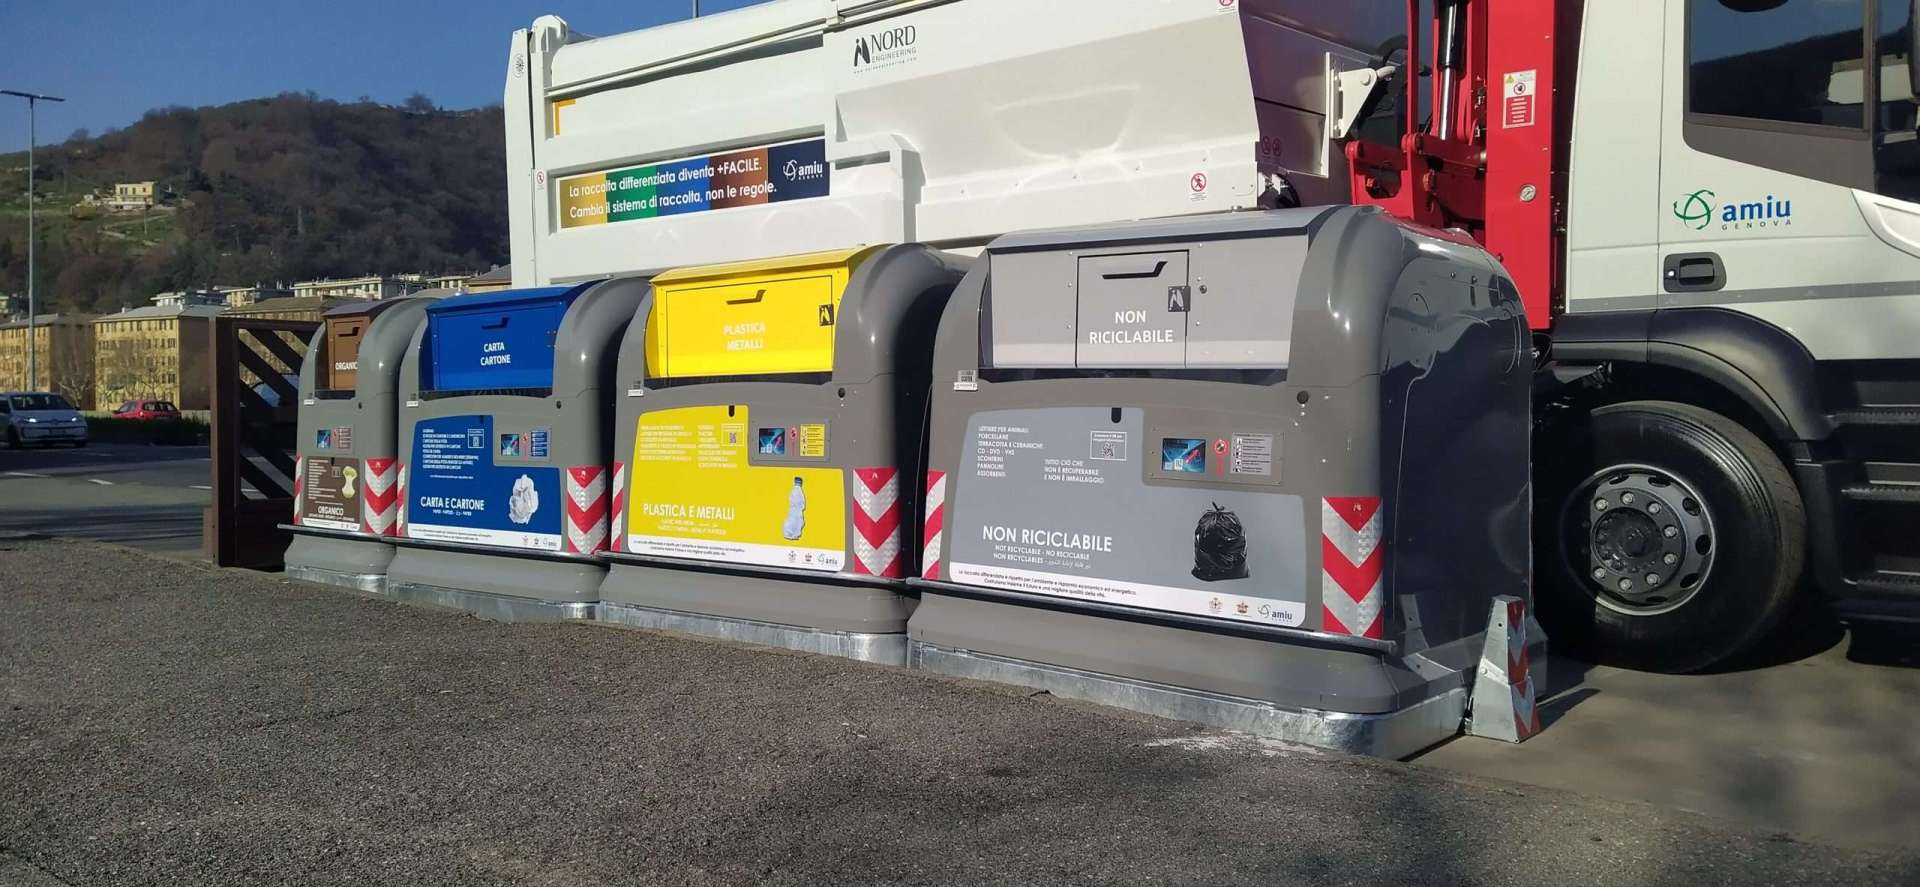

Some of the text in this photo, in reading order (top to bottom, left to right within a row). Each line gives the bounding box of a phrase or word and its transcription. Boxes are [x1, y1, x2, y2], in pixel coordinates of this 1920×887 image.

[871, 25, 916, 53] NORD
[871, 47, 917, 63] ENGINEERING
[798, 161, 823, 176] amiu
[569, 158, 762, 198] La raccolta differenziata diventa +FACILE.
[569, 180, 778, 218] Cambia il sistema di raccolta, non le regole.
[1722, 195, 1791, 222] amiu
[1721, 220, 1792, 231] GENOVA
[1114, 310, 1147, 324] NON
[723, 322, 767, 336] PLASTICA
[1089, 329, 1174, 344] RICICLABILE
[483, 342, 505, 353] CARTA
[727, 338, 764, 352] METALLI
[335, 361, 358, 370] ORGANIC
[480, 355, 512, 366] CARTONE
[420, 496, 485, 511] CARTA E CARTONE
[642, 503, 736, 520] PLASTICA E METALLI
[982, 525, 1112, 552] NON RICICLABILE
[995, 544, 1007, 552] NOT
[1007, 545, 1041, 555] RECYCLABLE
[1045, 549, 1055, 557] NO
[1007, 553, 1044, 564] RECYCLABLES
[1271, 610, 1293, 620] amiu
